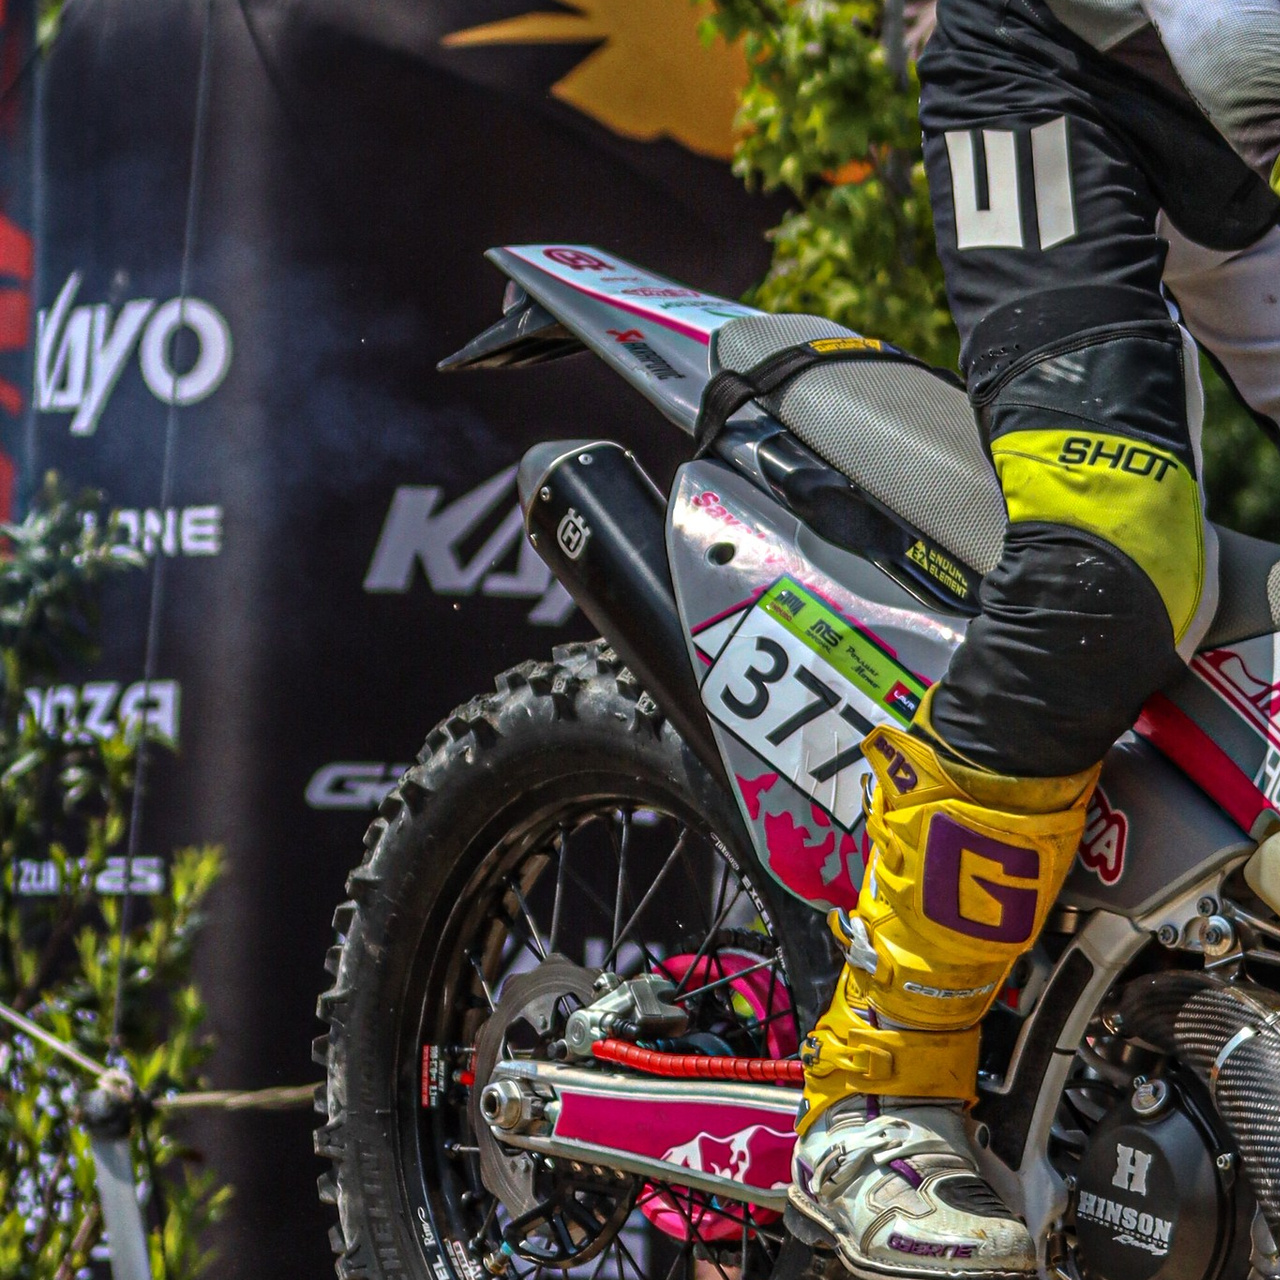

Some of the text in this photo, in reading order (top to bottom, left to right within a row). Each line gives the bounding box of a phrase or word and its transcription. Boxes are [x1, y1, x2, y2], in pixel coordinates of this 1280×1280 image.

[1058, 436, 1179, 484] SHOT
[929, 564, 969, 600] ELEMENT
[893, 688, 917, 712] LAVR
[741, 874, 774, 938] EXCEL
[417, 1206, 436, 1248] Rim
[1077, 1190, 1172, 1243] HINSON
